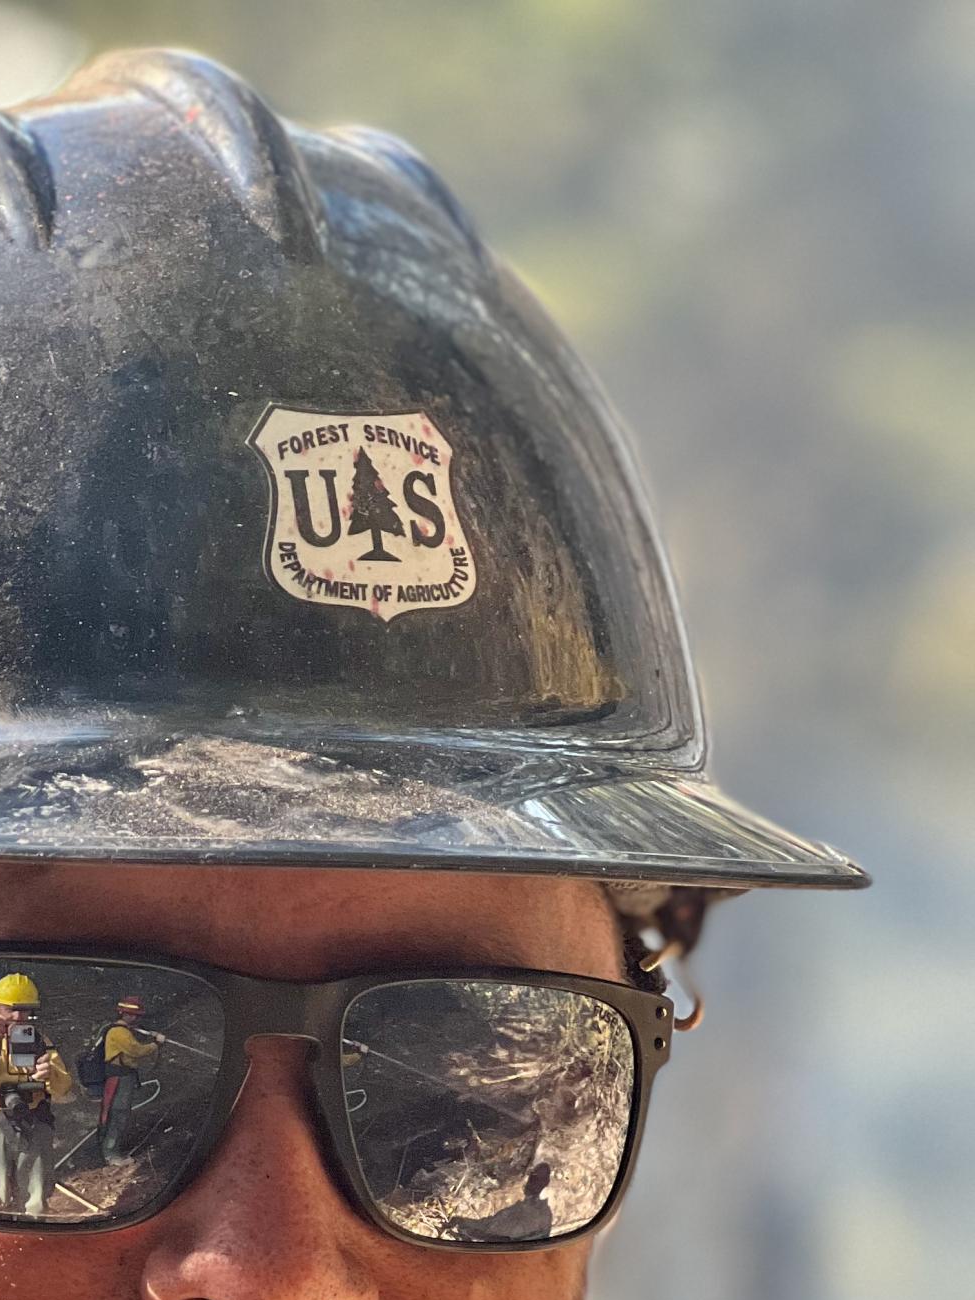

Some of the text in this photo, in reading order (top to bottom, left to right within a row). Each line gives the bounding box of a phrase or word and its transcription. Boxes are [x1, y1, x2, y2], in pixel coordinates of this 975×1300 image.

[277, 423, 441, 466] FOREST SERVICE
[278, 541, 469, 603] DEPARTMENT OF AGRICULTURE
